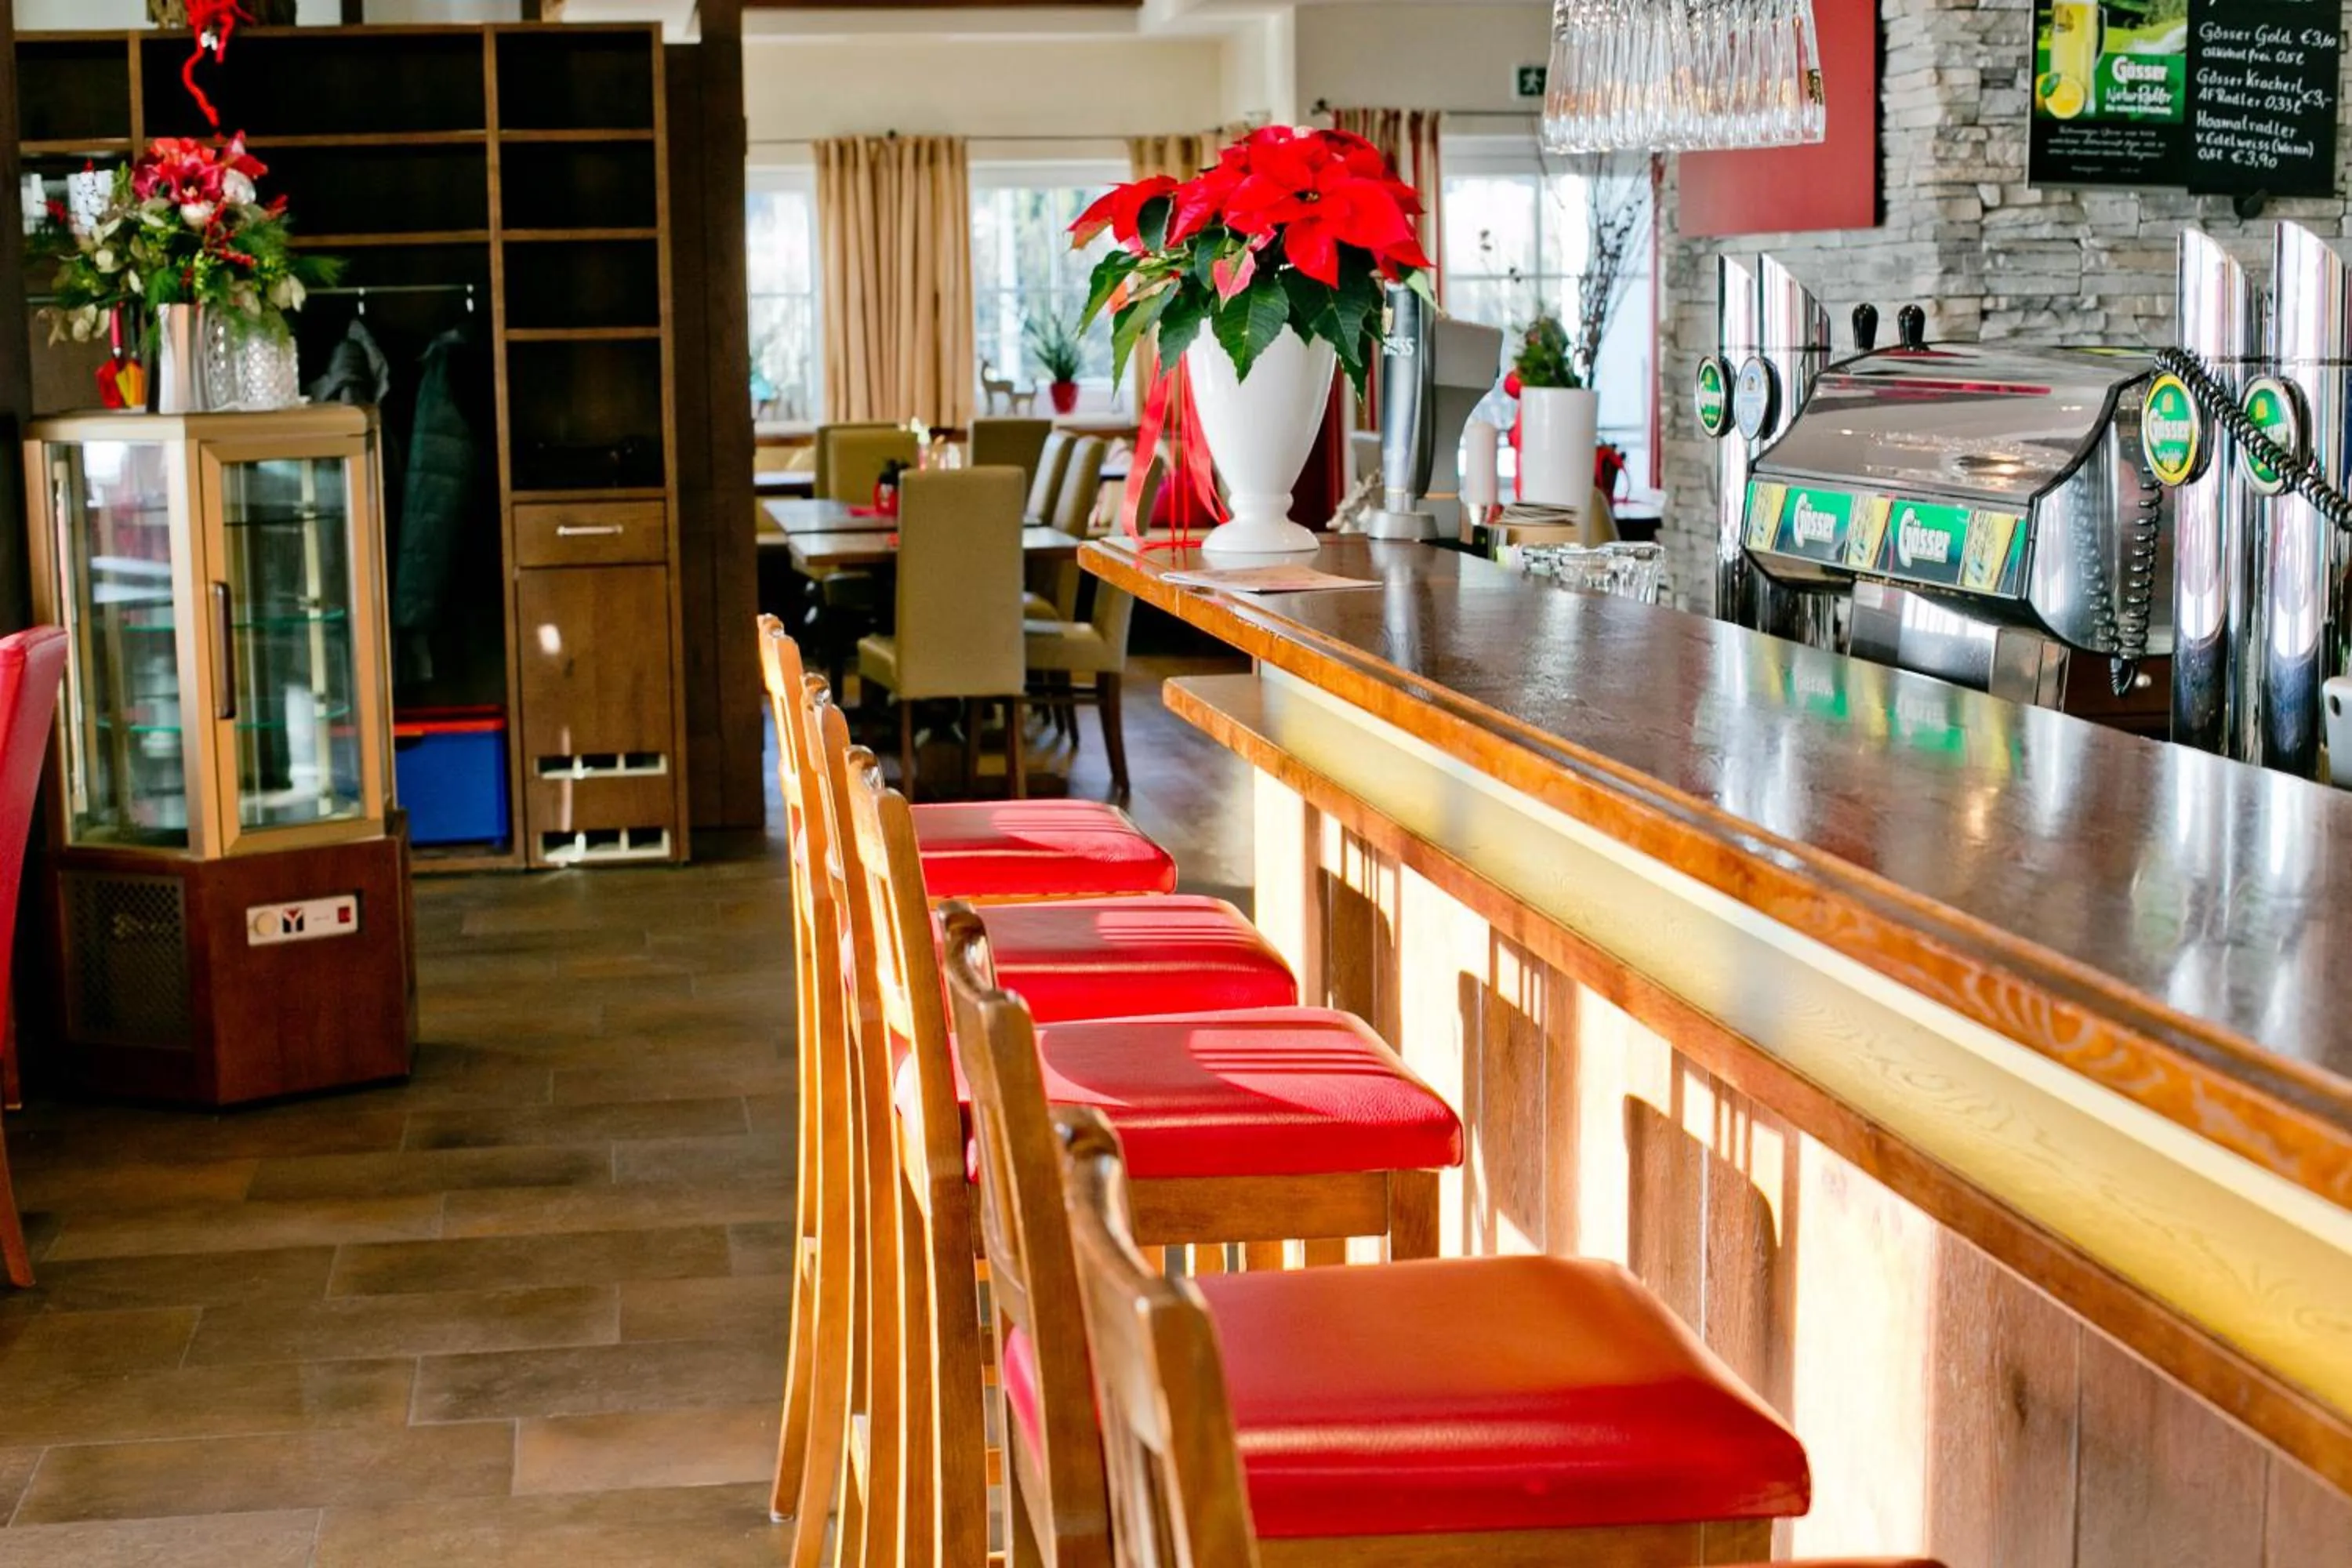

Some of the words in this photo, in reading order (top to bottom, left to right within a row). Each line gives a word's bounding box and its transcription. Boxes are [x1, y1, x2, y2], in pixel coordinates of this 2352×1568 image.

[2199, 21, 2251, 42] Gösser
[2254, 24, 2292, 48] Gold
[2111, 55, 2168, 85] Gösser
[2196, 67, 2242, 86] Gösser
[2230, 149, 2278, 169] €3,90
[1793, 492, 1838, 548] Gösser
[1897, 507, 1951, 569] Gösser
